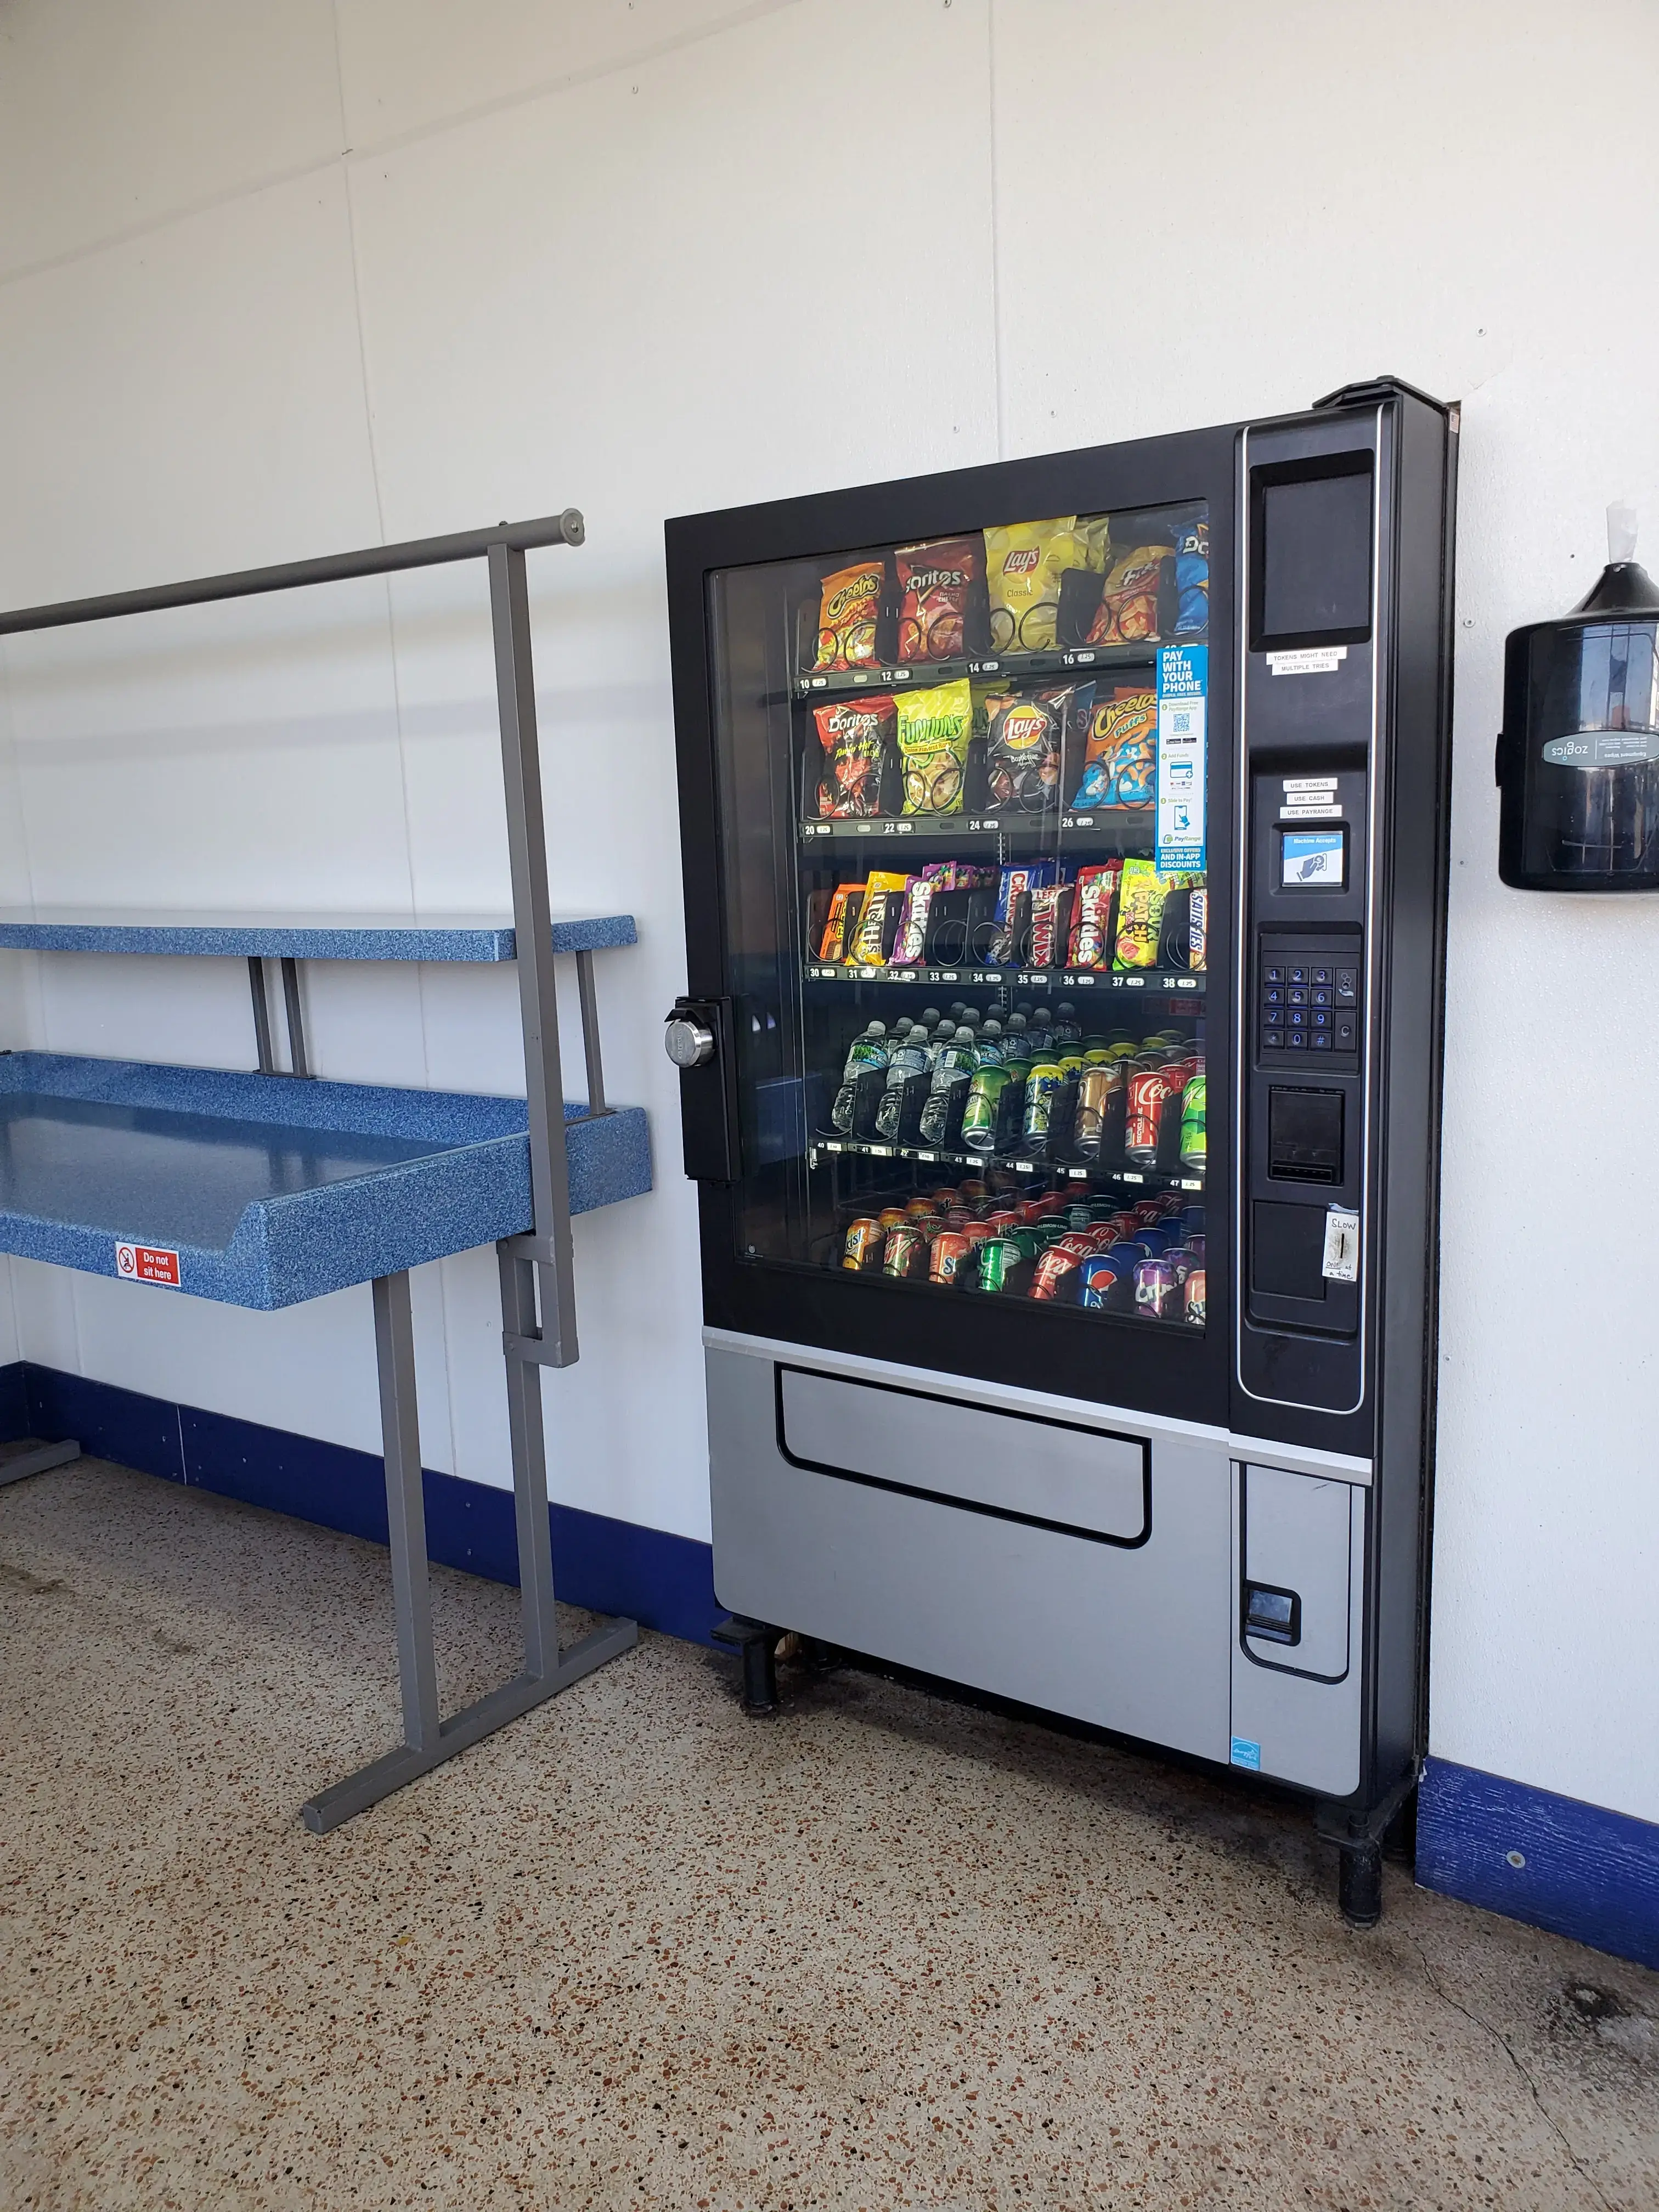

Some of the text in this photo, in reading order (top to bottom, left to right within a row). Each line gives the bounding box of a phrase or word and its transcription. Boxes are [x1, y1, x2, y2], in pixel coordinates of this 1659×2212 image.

[1003, 546, 1040, 574] Lay's
[1006, 588, 1034, 598] Classic
[1063, 654, 1074, 664] 16
[1163, 650, 1183, 662] PAY
[969, 663, 979, 673] 14
[1163, 660, 1192, 672] WITH
[882, 672, 891, 681] 12
[1163, 671, 1193, 682] YOUR
[800, 679, 810, 689] 10
[1163, 680, 1201, 693] PHONE
[828, 714, 879, 732] Doritos
[1551, 741, 1588, 761] zogics
[969, 820, 980, 830] 24
[1062, 817, 1073, 828] 26
[805, 825, 815, 836] 20
[885, 823, 895, 833] 22
[1133, 890, 1149, 944] PATCH
[1147, 890, 1164, 941] SOUR
[1078, 885, 1101, 963] Skittles
[810, 968, 819, 977] 30
[849, 969, 857, 978] 31
[889, 971, 899, 980] 32
[930, 972, 939, 981] 33
[1272, 970, 1277, 979] 1
[1295, 970, 1302, 980] 2
[1318, 971, 1325, 980] 3
[973, 974, 983, 983] 34
[1018, 975, 1028, 984] 35
[1063, 976, 1074, 985] 36
[1112, 977, 1124, 986] 37
[1163, 978, 1175, 988] 38
[1270, 991, 1277, 1000] 4
[1294, 992, 1301, 1001] 5
[1318, 992, 1325, 1002] 6
[1270, 1012, 1277, 1022] 7
[1294, 1013, 1301, 1023] 8
[1317, 1014, 1324, 1024] 9
[1341, 1026, 1350, 1036] C
[1294, 1034, 1301, 1044] 0
[1331, 1218, 1356, 1230] SLOW
[143, 1251, 169, 1266] Do not
[144, 1266, 172, 1280] sit here
[1336, 1271, 1353, 1279] time
